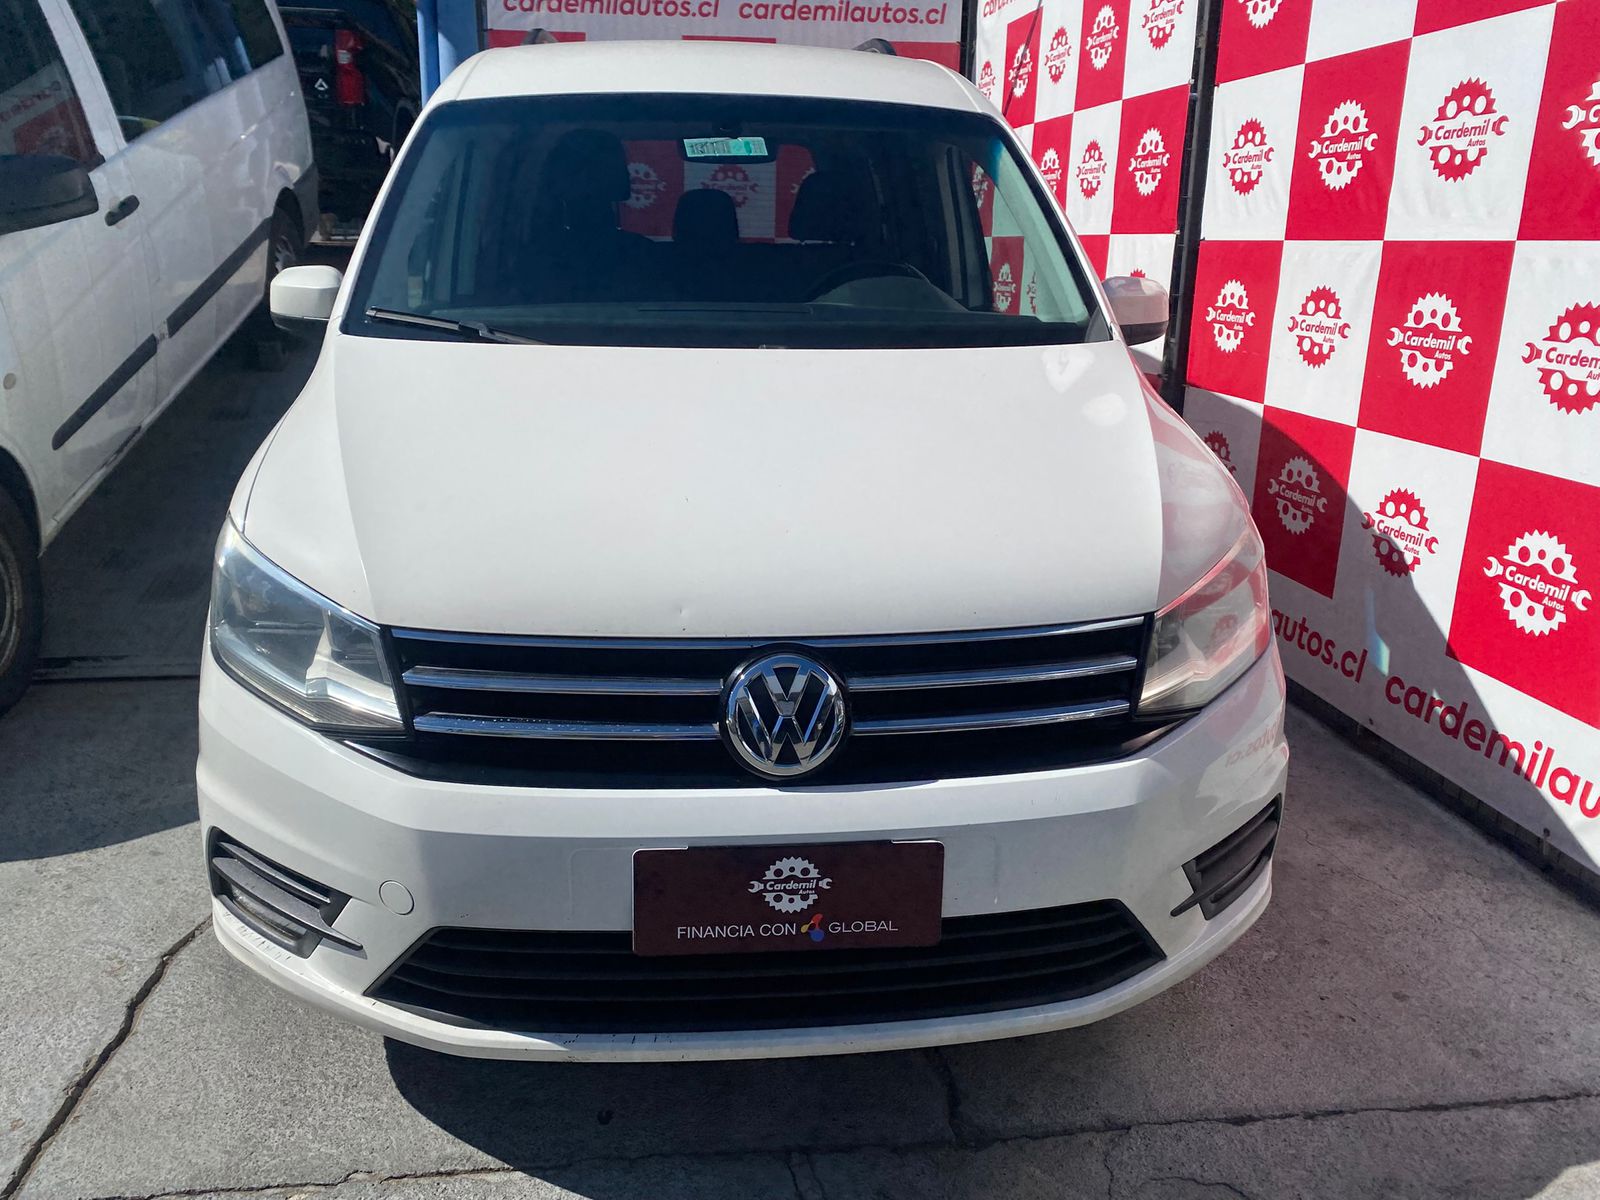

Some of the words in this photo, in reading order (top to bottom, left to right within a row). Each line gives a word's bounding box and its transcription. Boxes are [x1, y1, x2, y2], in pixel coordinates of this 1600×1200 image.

[738, 0, 947, 25] cardemilautos.cl
[1434, 118, 1491, 141] Cardemil
[1322, 135, 1364, 155] Cardemil
[1232, 149, 1264, 165] Cardemil
[1216, 309, 1246, 324] Cardemil
[1300, 319, 1339, 336] Cardemil
[1404, 330, 1457, 351] Cardemil
[1434, 349, 1452, 360] Autos
[1279, 484, 1317, 507] Cardemil
[1376, 519, 1424, 547] Cardemil
[1505, 565, 1571, 602] Cardemil
[1541, 595, 1565, 612] Autos
[1385, 675, 1600, 819] cardemilau
[766, 879, 817, 891] Cardemil
[676, 925, 755, 940] FINANCIA
[759, 923, 797, 937] CON
[828, 920, 899, 934] GLOBAL
